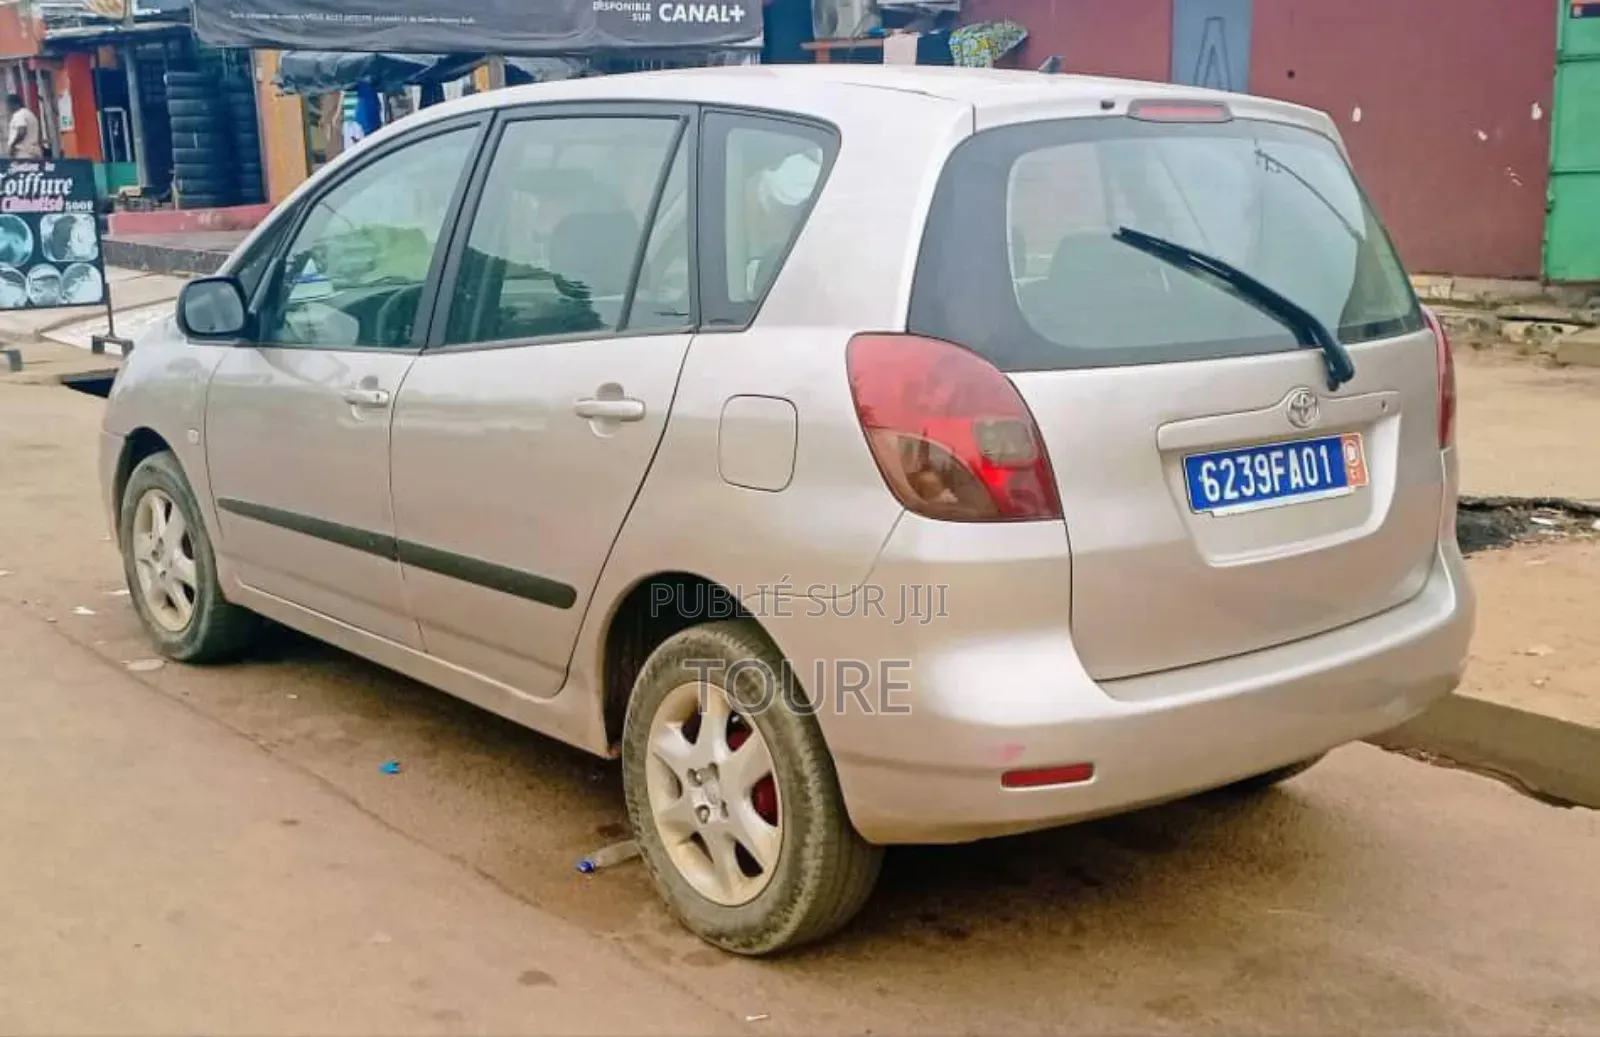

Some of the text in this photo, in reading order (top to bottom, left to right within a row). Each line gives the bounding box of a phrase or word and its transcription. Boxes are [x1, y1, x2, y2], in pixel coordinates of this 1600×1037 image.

[593, 1, 652, 11] DISPONIBLE
[658, 3, 746, 22] CANAL+
[632, 12, 651, 21] SUR
[1200, 445, 1332, 502] 6239FA01
